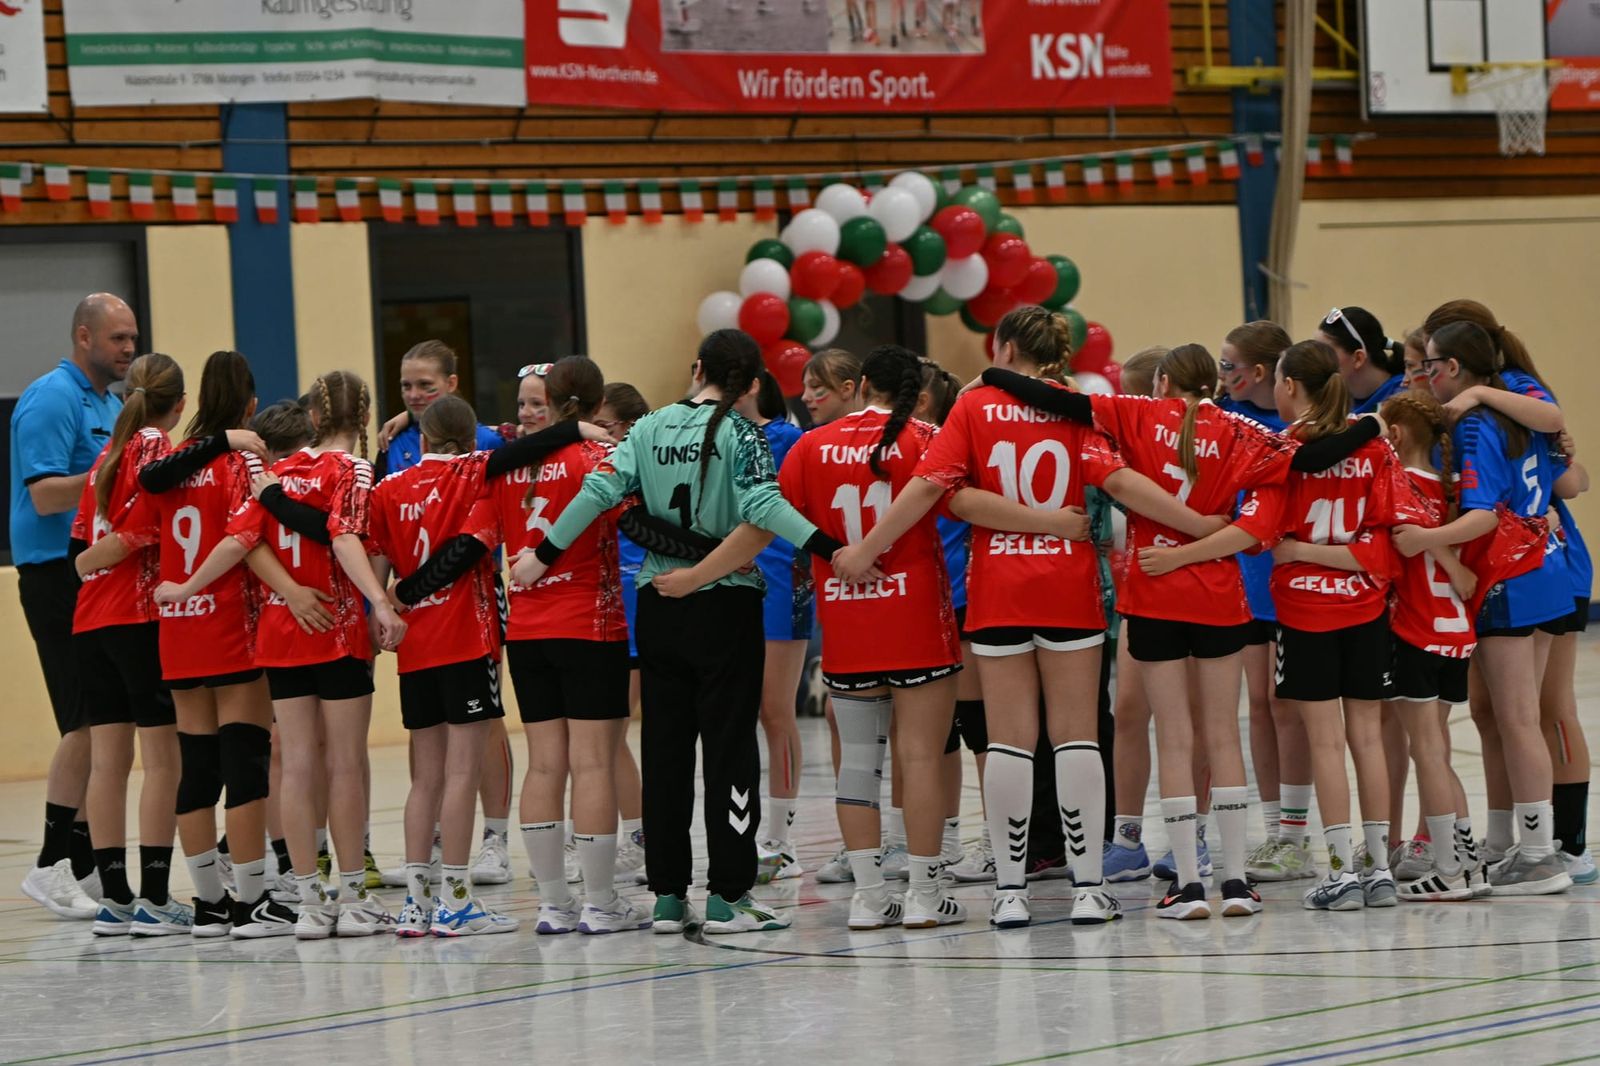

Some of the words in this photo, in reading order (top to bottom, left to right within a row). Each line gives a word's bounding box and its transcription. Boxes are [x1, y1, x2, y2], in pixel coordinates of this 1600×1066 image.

[1030, 32, 1105, 79] KSN
[737, 68, 779, 99] Wir
[784, 67, 865, 99] fördern
[868, 68, 936, 106] Sport.
[982, 403, 1072, 423] TUNIS
[653, 440, 721, 466] UNISA
[1155, 424, 1220, 459] TUSIA
[987, 439, 1070, 513] 10
[521, 496, 553, 543] 3
[669, 483, 692, 529] 1
[831, 480, 893, 550] 11
[172, 505, 201, 575] 9
[989, 532, 1073, 556] SELECT
[159, 594, 217, 618] ELECT
[824, 571, 908, 602] SELECT
